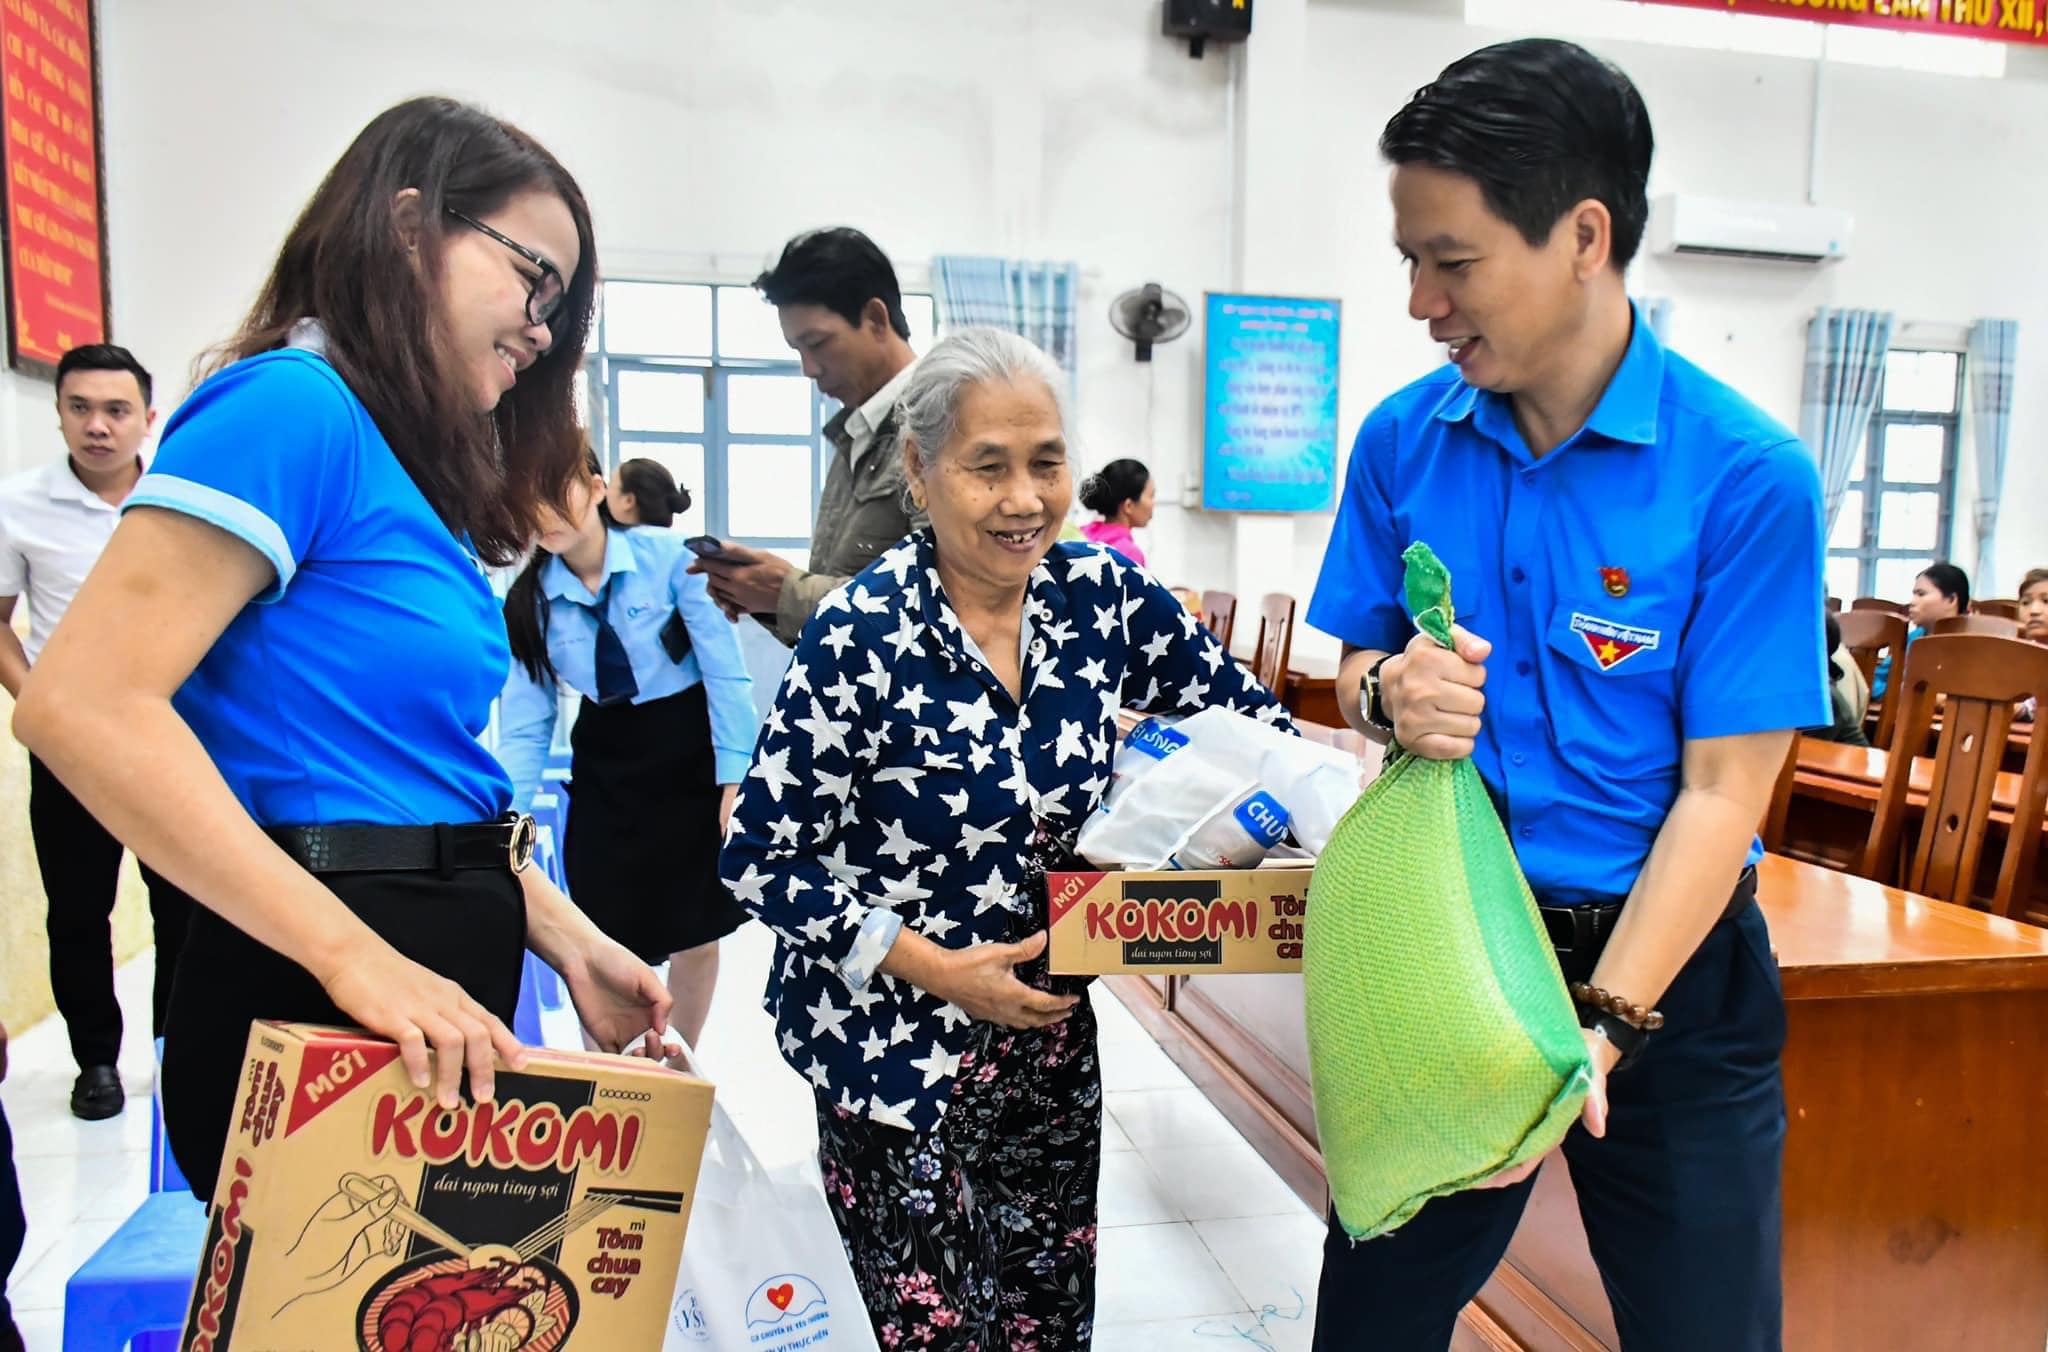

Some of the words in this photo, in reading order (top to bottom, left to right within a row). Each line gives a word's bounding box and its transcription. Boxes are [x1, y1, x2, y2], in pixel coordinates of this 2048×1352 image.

[1053, 876, 1086, 909] MỚI
[1085, 900, 1259, 941] KOKOMI
[1268, 918, 1304, 940] chu
[1276, 942, 1303, 959] ca
[305, 1049, 368, 1104] MỚI
[370, 1091, 643, 1174] KOKOMI
[433, 1172, 460, 1191] dai
[462, 1180, 500, 1200] ngon
[630, 1218, 647, 1232] mì
[596, 1226, 644, 1250] Tôm
[586, 1252, 642, 1275] chua
[590, 1276, 632, 1300] cay
